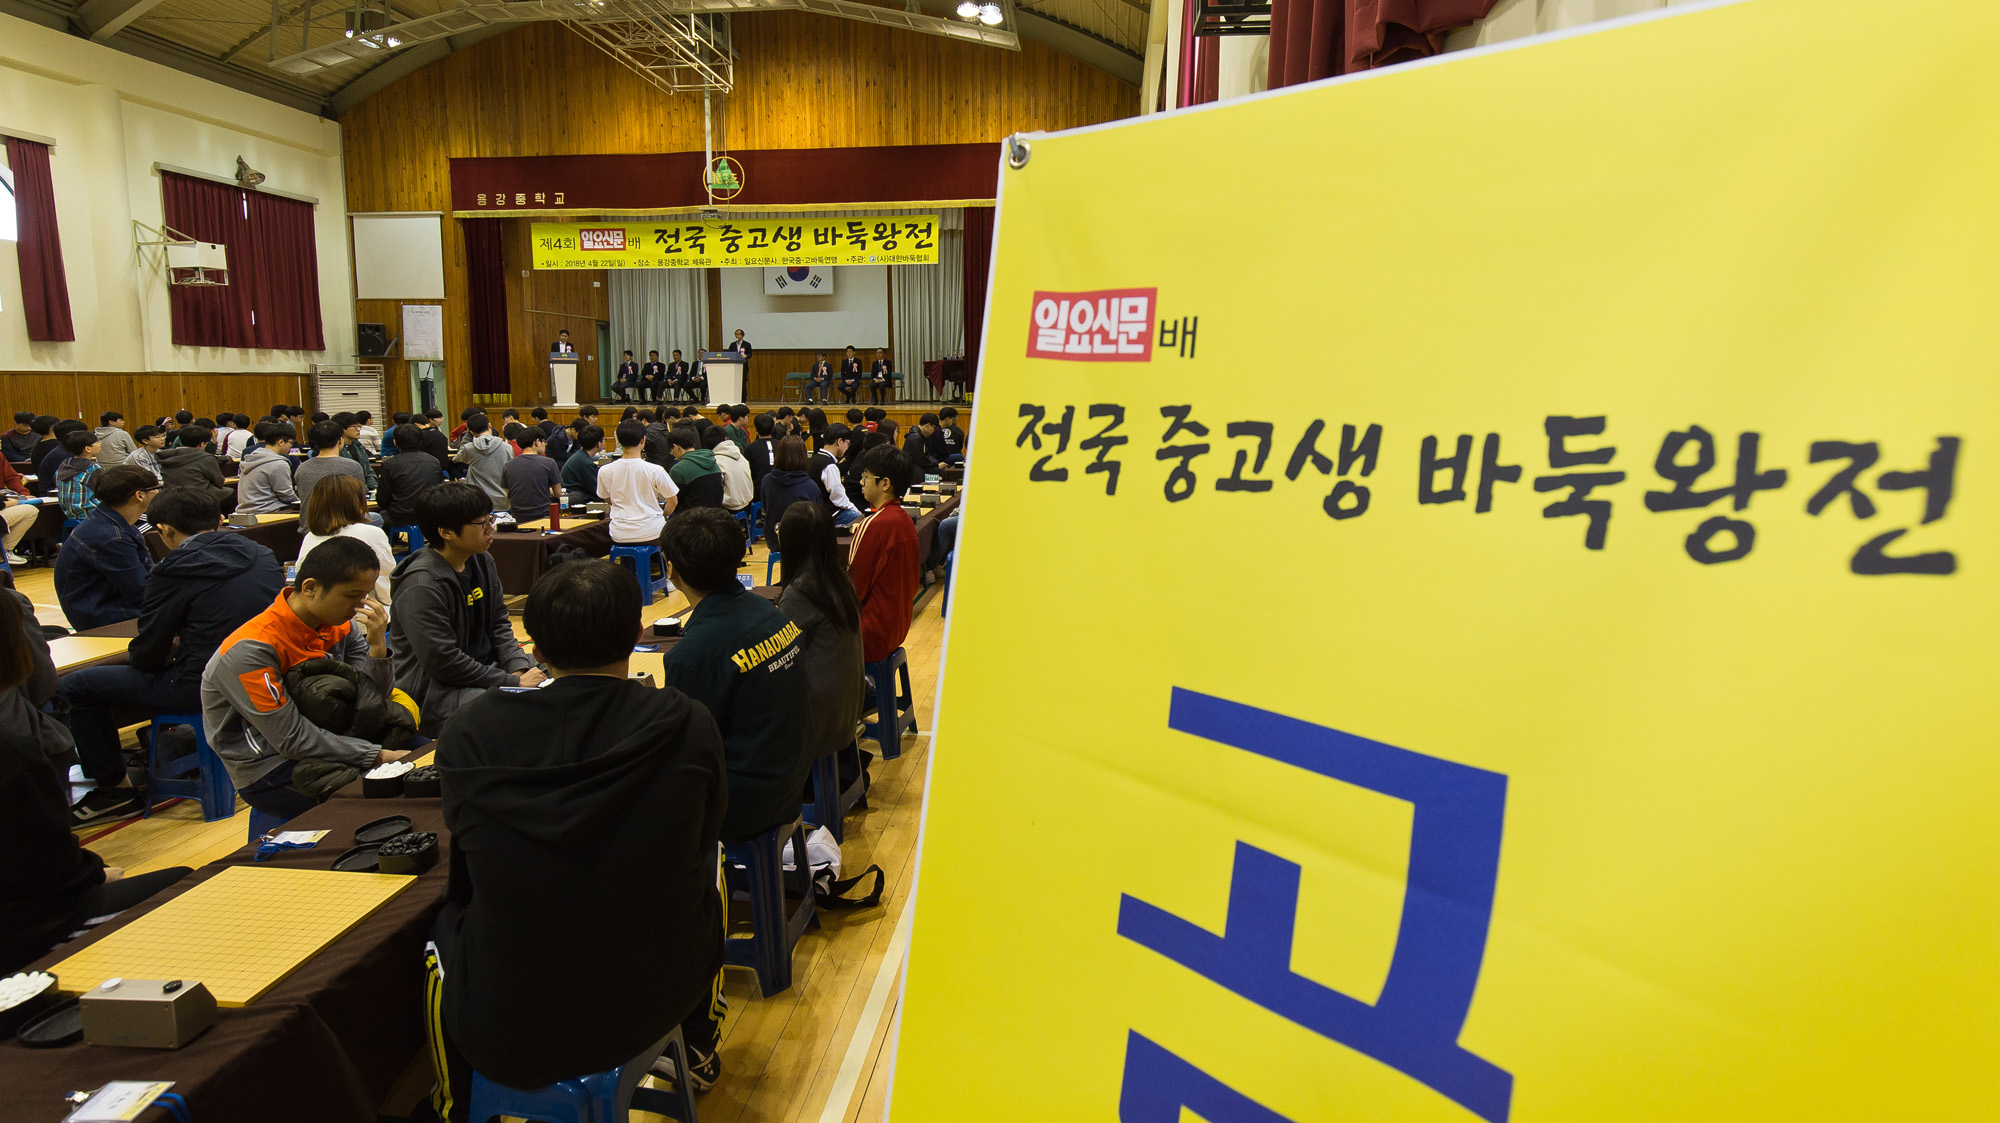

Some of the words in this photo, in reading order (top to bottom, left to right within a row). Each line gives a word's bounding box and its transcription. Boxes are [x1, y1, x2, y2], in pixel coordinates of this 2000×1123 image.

[477, 192, 565, 206] 용강중학교
[539, 237, 576, 250] 제4회
[581, 230, 625, 249] 일요신문
[628, 236, 641, 249] 배
[654, 226, 706, 254] 전국
[718, 223, 802, 253] 중고생
[813, 221, 934, 250] 바둑왕전
[638, 259, 650, 267] 장소
[657, 258, 690, 266] 용강중학교
[692, 258, 712, 266] 체육관
[1034, 297, 1149, 354] 일요신문
[1159, 316, 1198, 358] 배
[1015, 403, 1129, 496] 전국
[1154, 404, 1383, 520] 중고생
[1417, 415, 1962, 576] 바둑왕전
[731, 620, 802, 673] HANAUMABA
[1117, 686, 1514, 1123] 고
